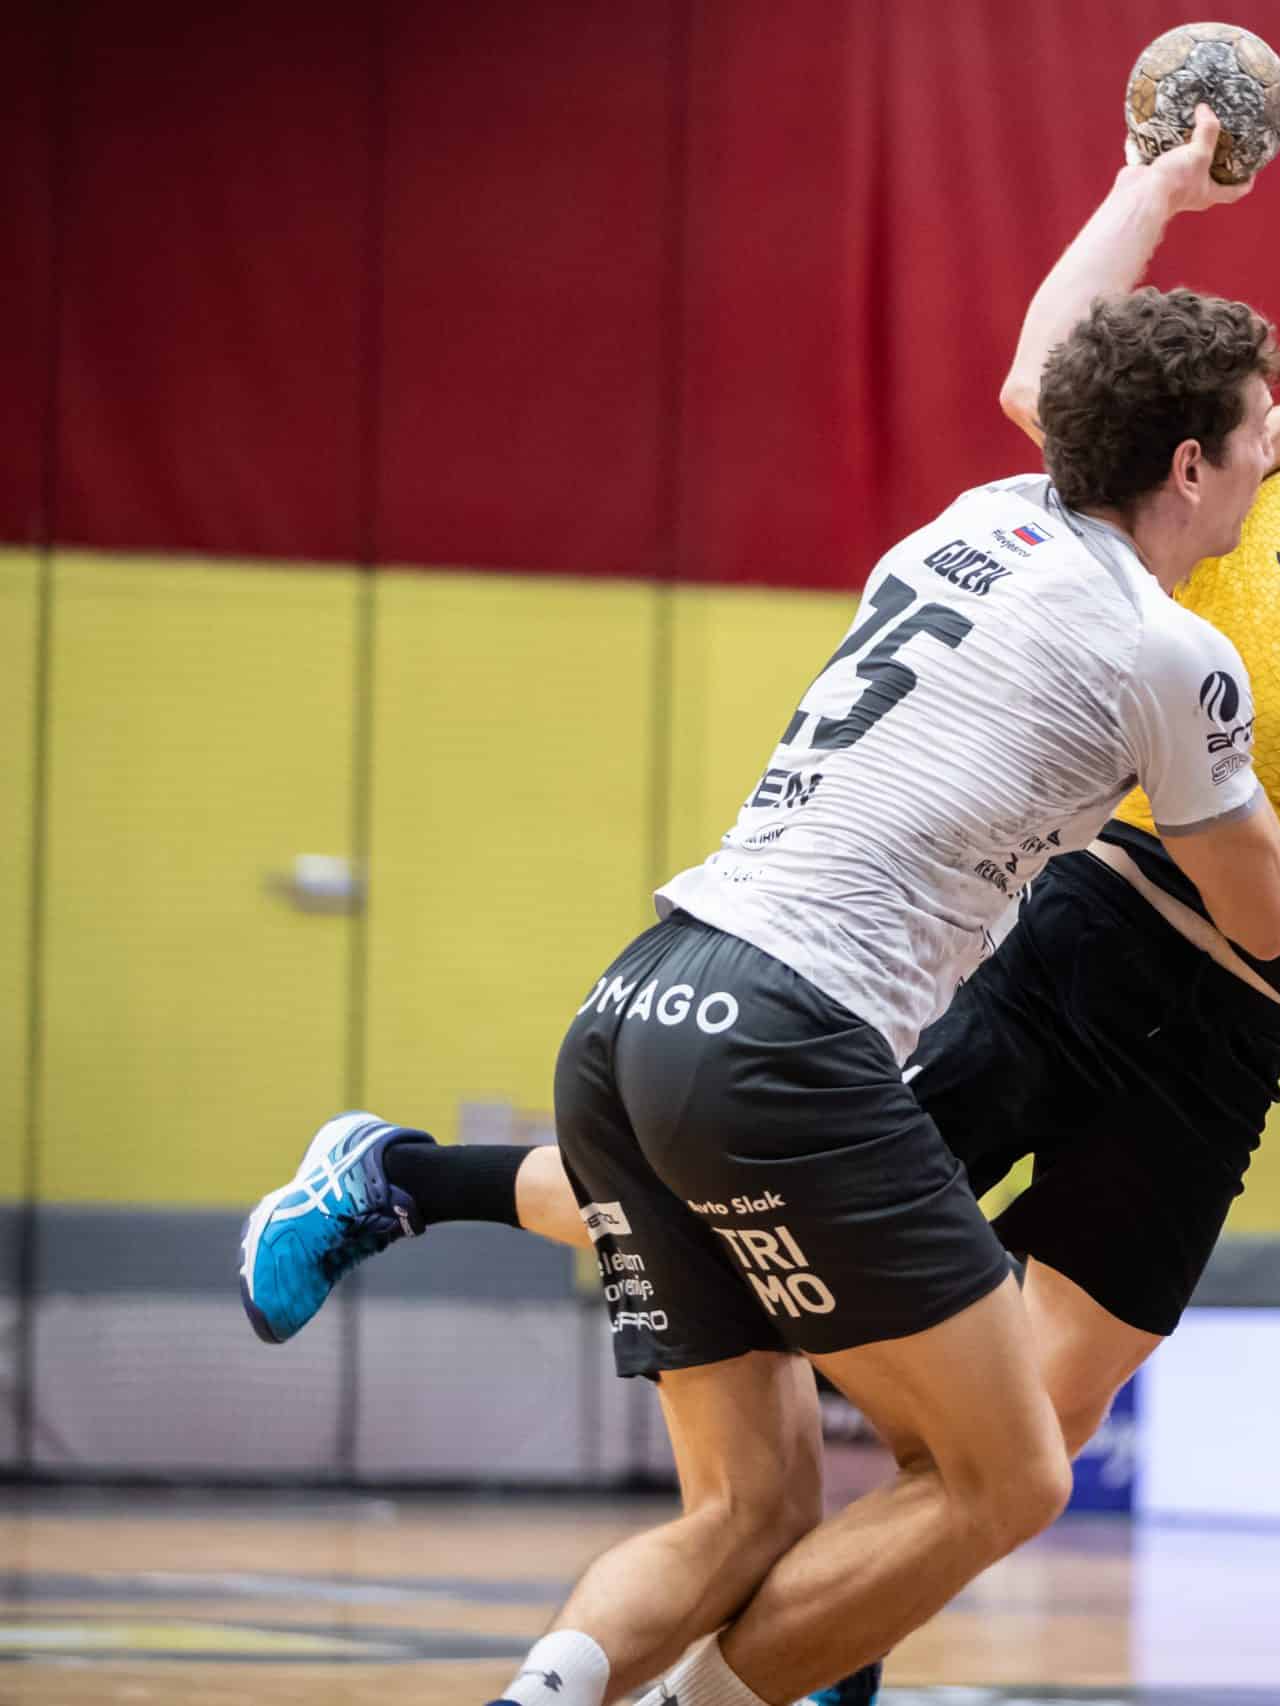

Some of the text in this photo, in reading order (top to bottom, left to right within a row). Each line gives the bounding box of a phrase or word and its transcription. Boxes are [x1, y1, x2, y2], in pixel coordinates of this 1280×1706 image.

[731, 1190, 786, 1215] Slak
[712, 1225, 809, 1270] TRI
[747, 1272, 837, 1318] MO
